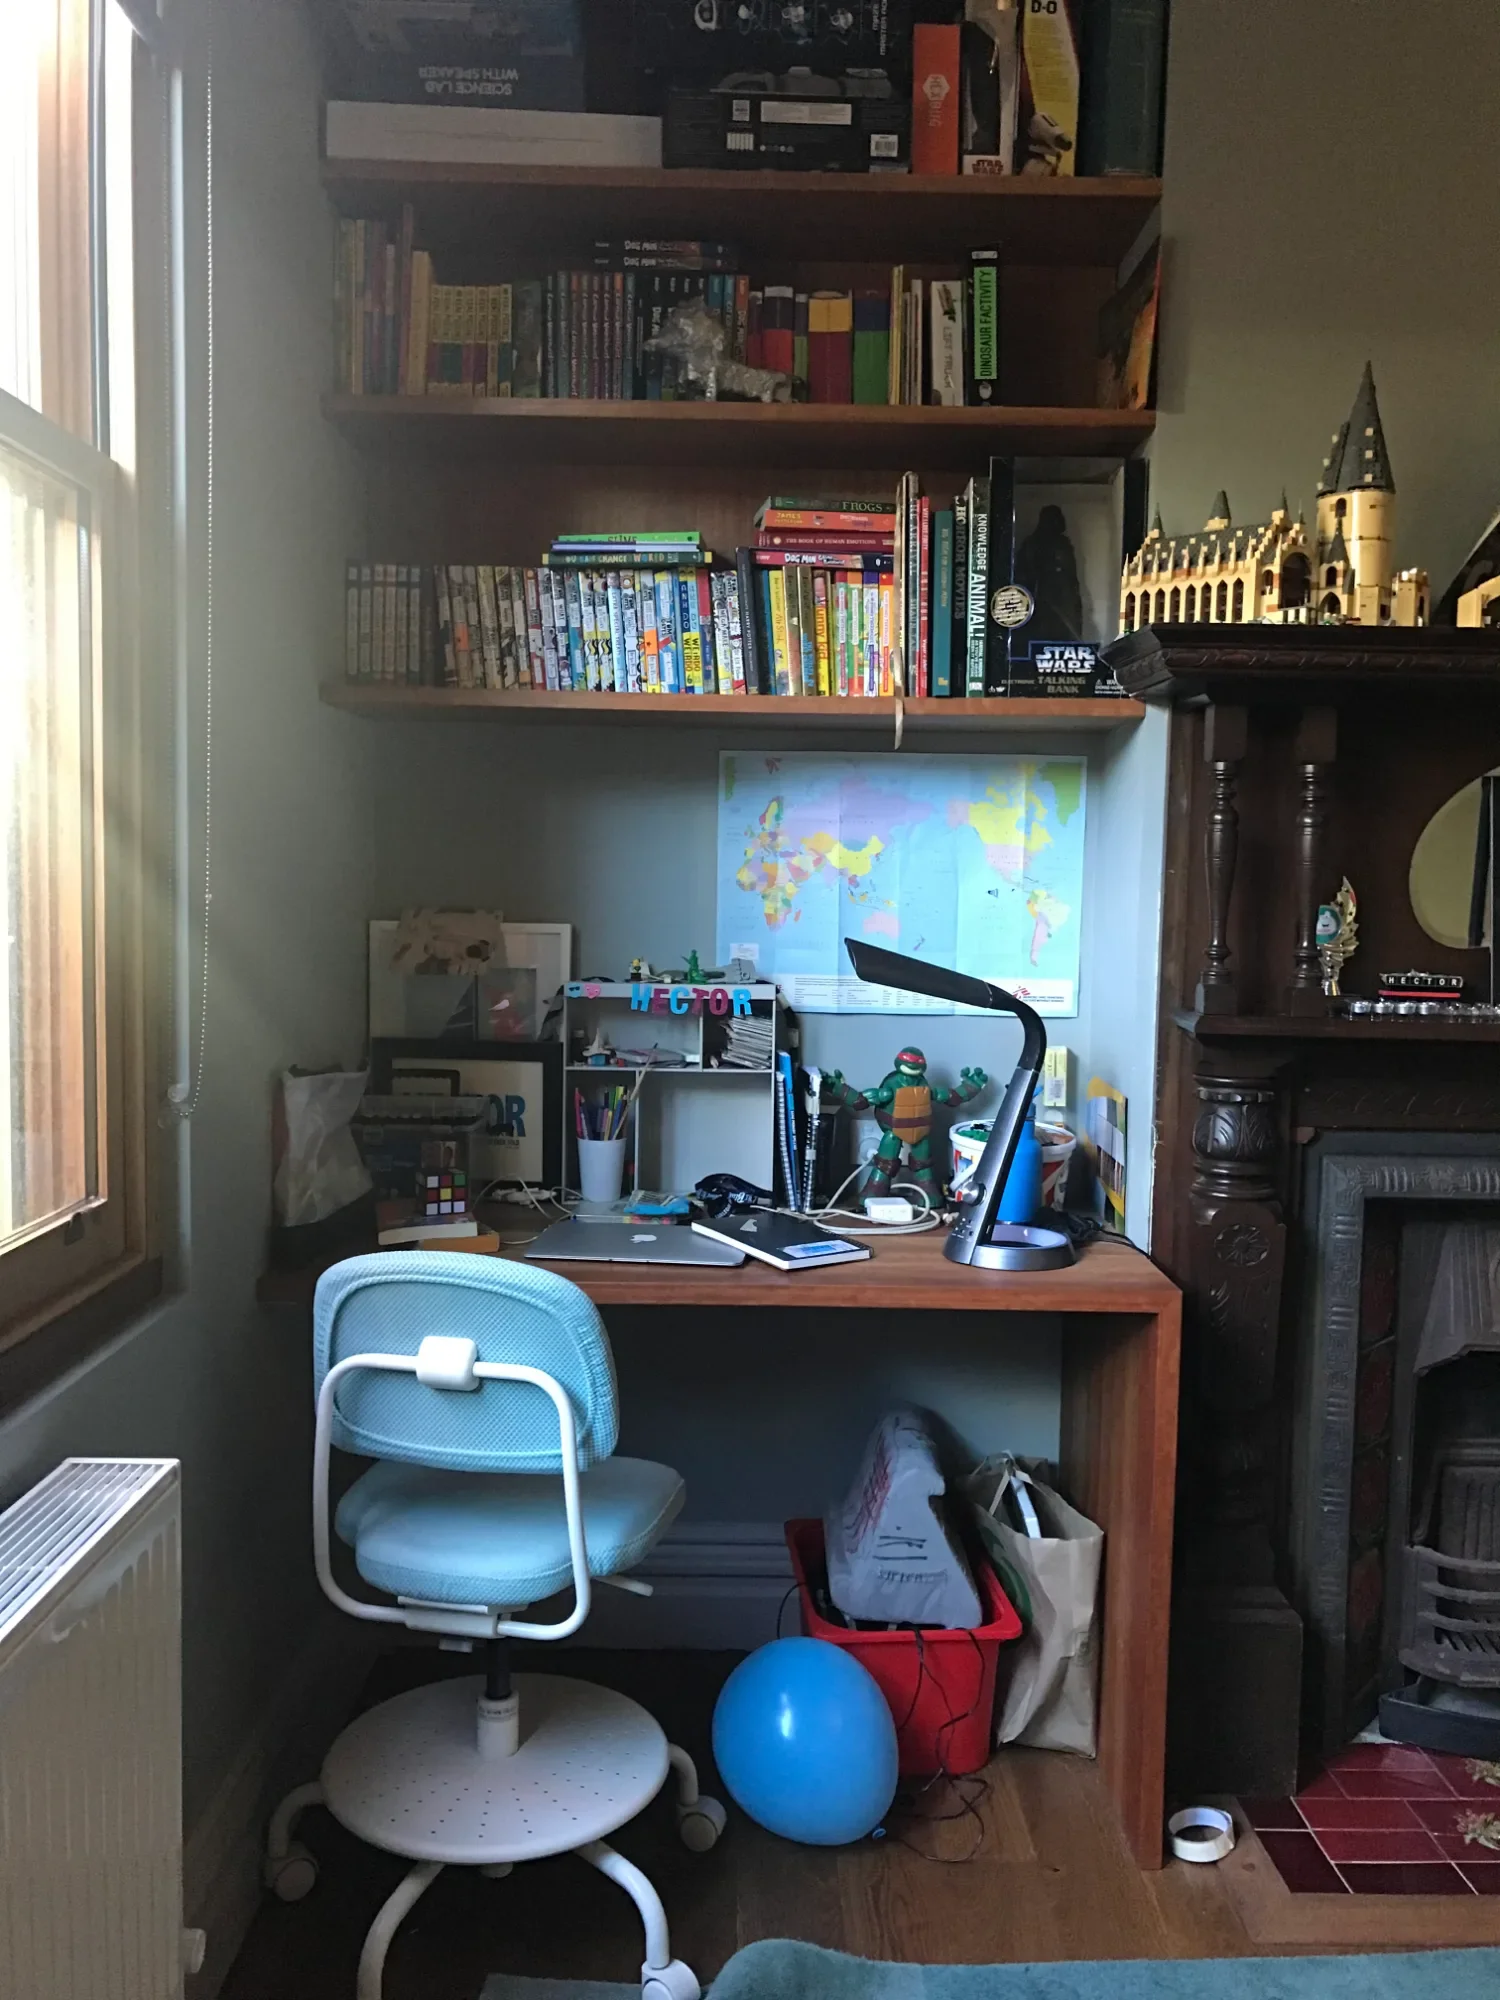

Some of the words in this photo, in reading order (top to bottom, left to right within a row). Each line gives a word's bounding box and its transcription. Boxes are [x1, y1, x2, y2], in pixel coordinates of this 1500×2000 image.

[418, 66, 480, 80] SPEAKER
[482, 67, 519, 80] WITH
[424, 80, 453, 93] LAB
[455, 81, 513, 96] SCIENCE
[975, 159, 1003, 168] STAR
[979, 270, 993, 324] FACTIVITY
[979, 326, 993, 377] DINOSAUR
[842, 501, 883, 513] FROGS
[955, 505, 967, 564] HORROR
[976, 513, 987, 571] KNOWLEDGE
[909, 524, 918, 576] ARRIVAL
[784, 552, 800, 563] DOG
[801, 554, 817, 564] MAN
[954, 566, 966, 620] MOVIES
[969, 573, 985, 637] ANIMAL!
[719, 608, 728, 628] MEGA
[1035, 646, 1096, 660] STAR
[1035, 659, 1096, 674] WARS
[1037, 675, 1086, 685] TALKING
[1047, 685, 1080, 693] BANK
[1388, 976, 1458, 986] HECTOR
[630, 983, 752, 1016] HECTOR
